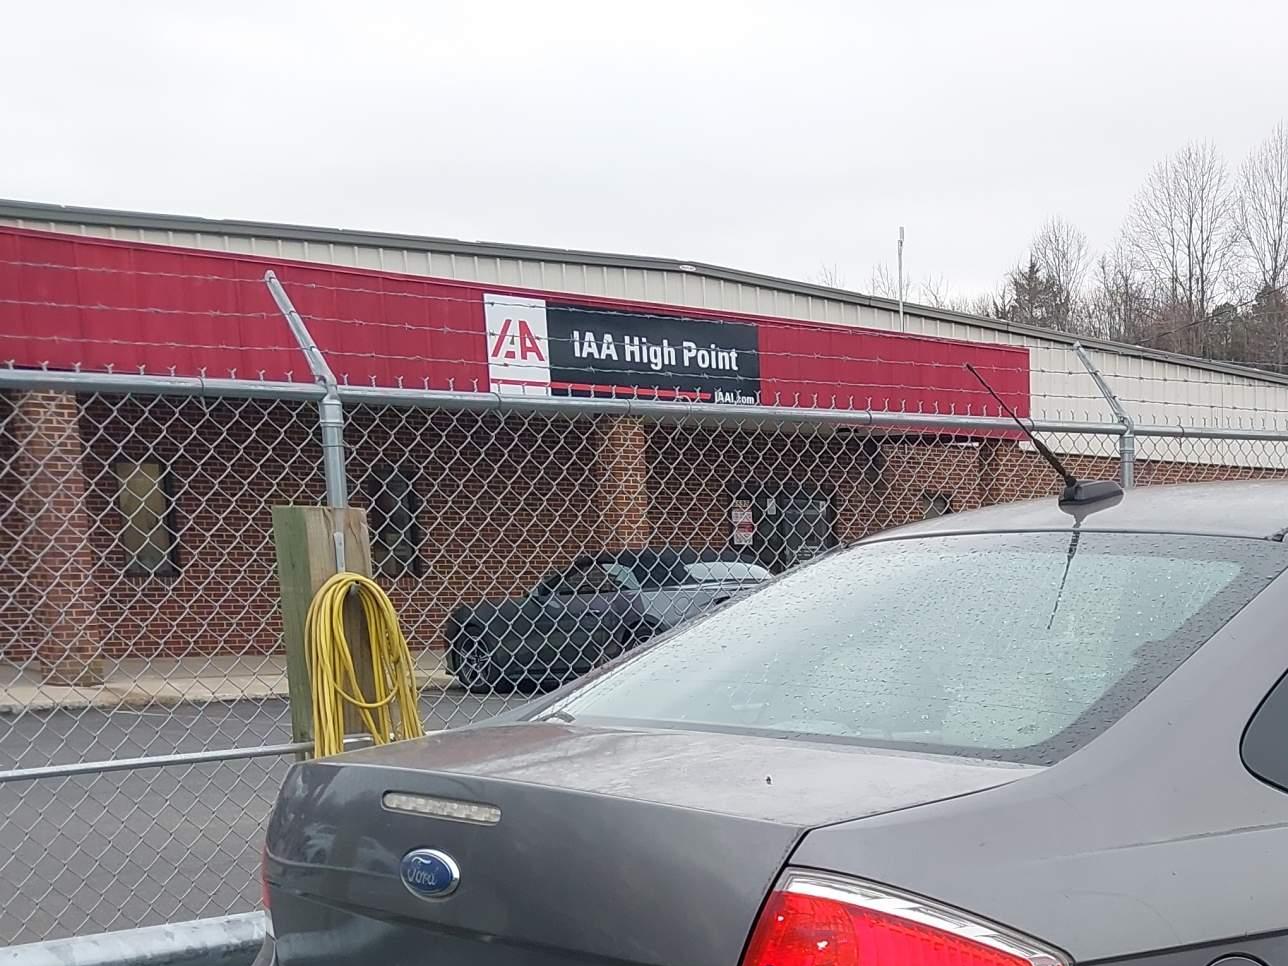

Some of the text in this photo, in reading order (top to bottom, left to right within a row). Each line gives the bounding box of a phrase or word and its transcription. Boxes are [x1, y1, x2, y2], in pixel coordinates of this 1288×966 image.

[573, 330, 739, 371] IAA High Point
[407, 856, 440, 886] Ford
